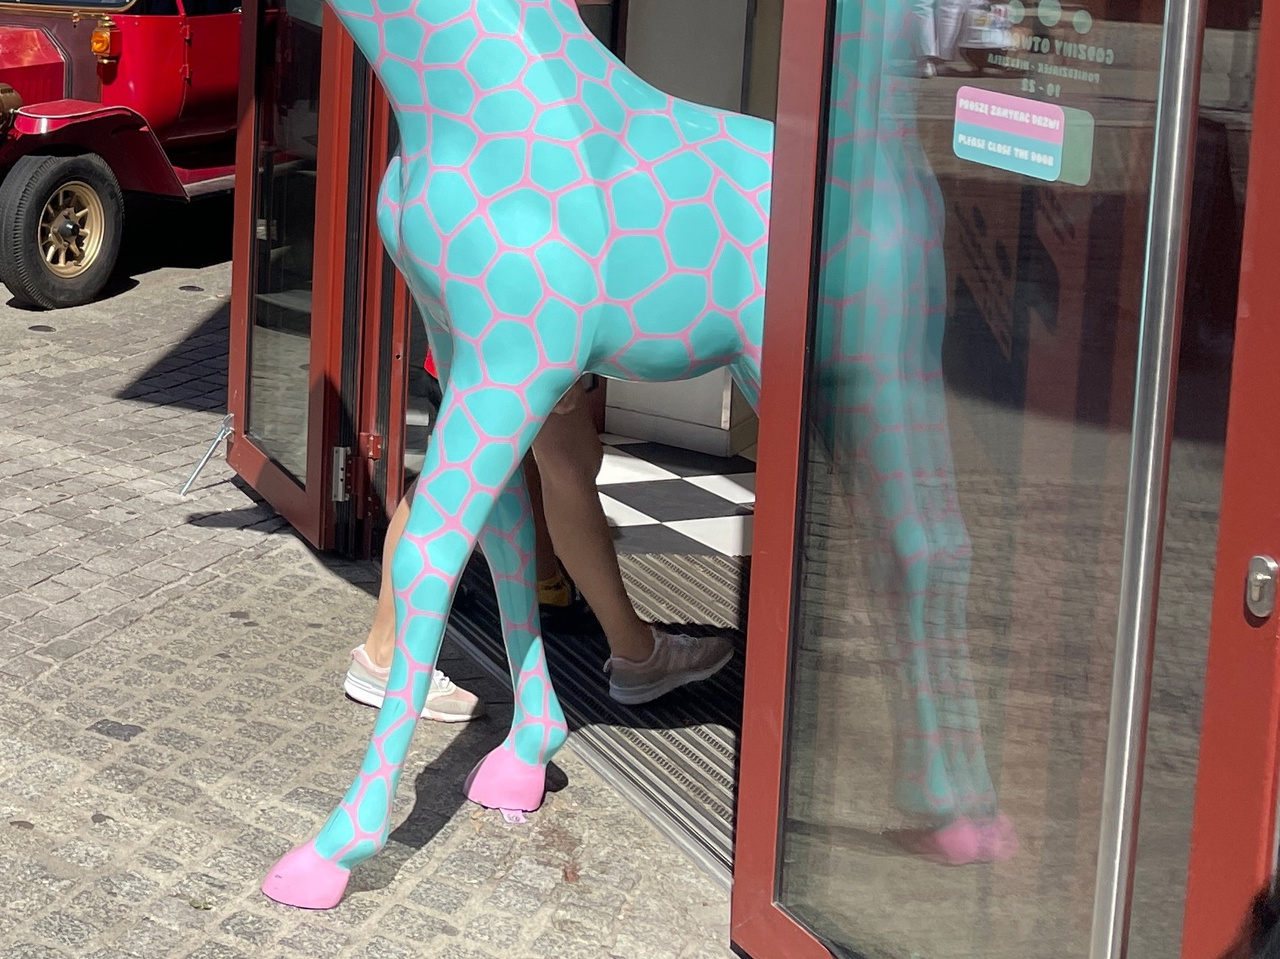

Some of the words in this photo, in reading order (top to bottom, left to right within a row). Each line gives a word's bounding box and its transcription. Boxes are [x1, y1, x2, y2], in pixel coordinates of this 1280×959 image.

[958, 98, 989, 116] PROSZĘ
[1032, 114, 1060, 131] DRZWI
[958, 133, 986, 150] PLEASE
[987, 141, 1012, 156] CLOSE
[1014, 147, 1029, 160] THE
[1031, 152, 1054, 167] DOOR
